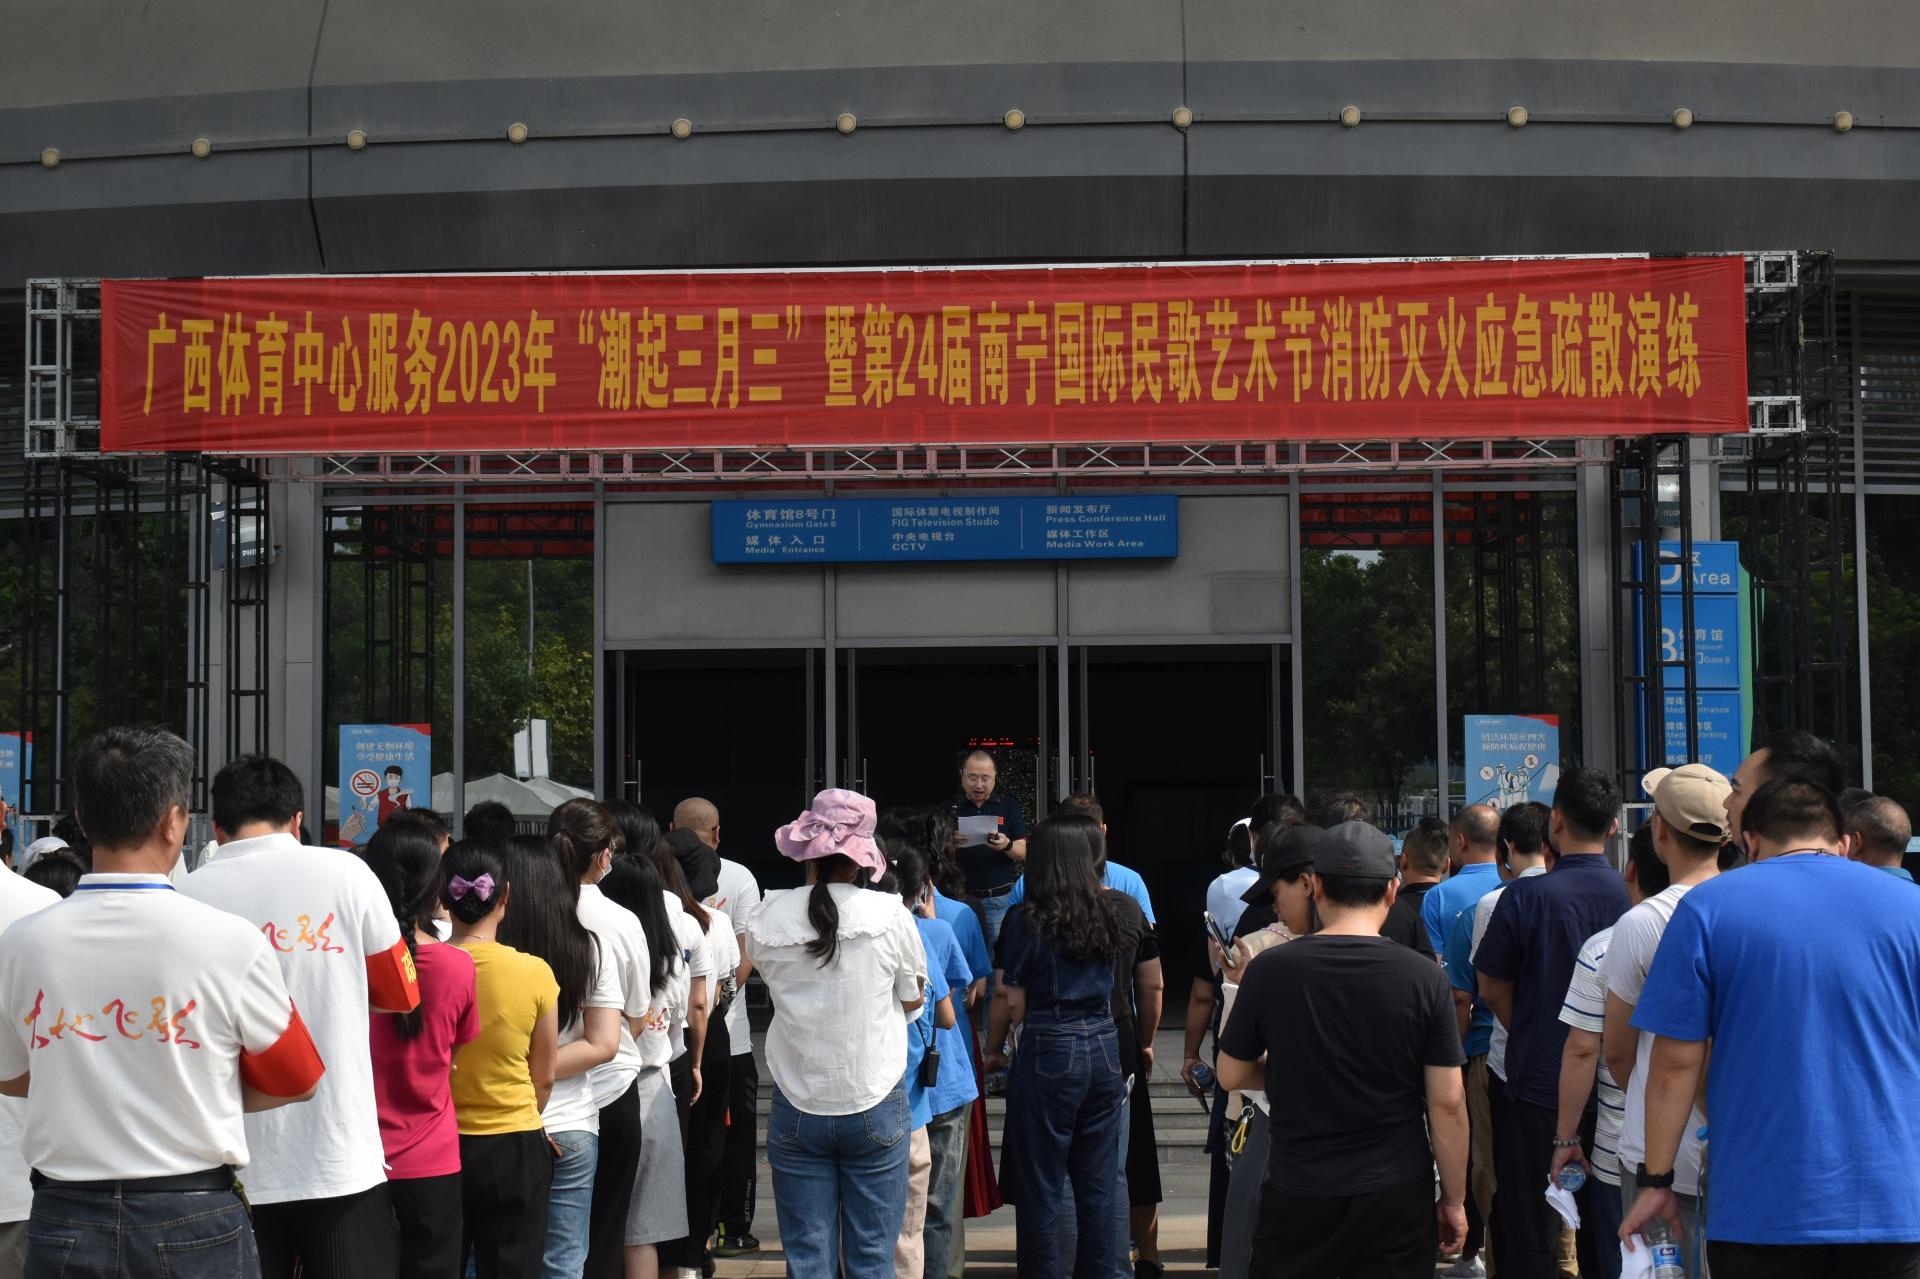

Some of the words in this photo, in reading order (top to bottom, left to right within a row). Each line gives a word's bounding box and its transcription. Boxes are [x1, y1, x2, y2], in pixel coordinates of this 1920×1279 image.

[746, 508, 836, 520] 体育馆8号门
[892, 506, 1000, 517] 国际体联电视制作间
[1046, 504, 1111, 514] 新闻发布厅
[892, 518, 909, 527] FIG
[911, 518, 963, 526] Television
[965, 517, 1000, 526] Studio
[1046, 515, 1076, 523] Press
[1078, 515, 1142, 523] Conference
[1144, 514, 1166, 522] Hall
[746, 521, 803, 529] Gymnasium
[892, 532, 955, 542] 中央电视台
[1046, 529, 1110, 539] 媒体工作区
[745, 535, 825, 545] 媒体入口
[1084, 540, 1114, 548] Work
[745, 546, 775, 554] Media
[892, 543, 926, 551] CCTV
[1666, 696, 1703, 706] 媒体口
[1696, 706, 1730, 714] ntrance
[1697, 731, 1728, 740] orking
